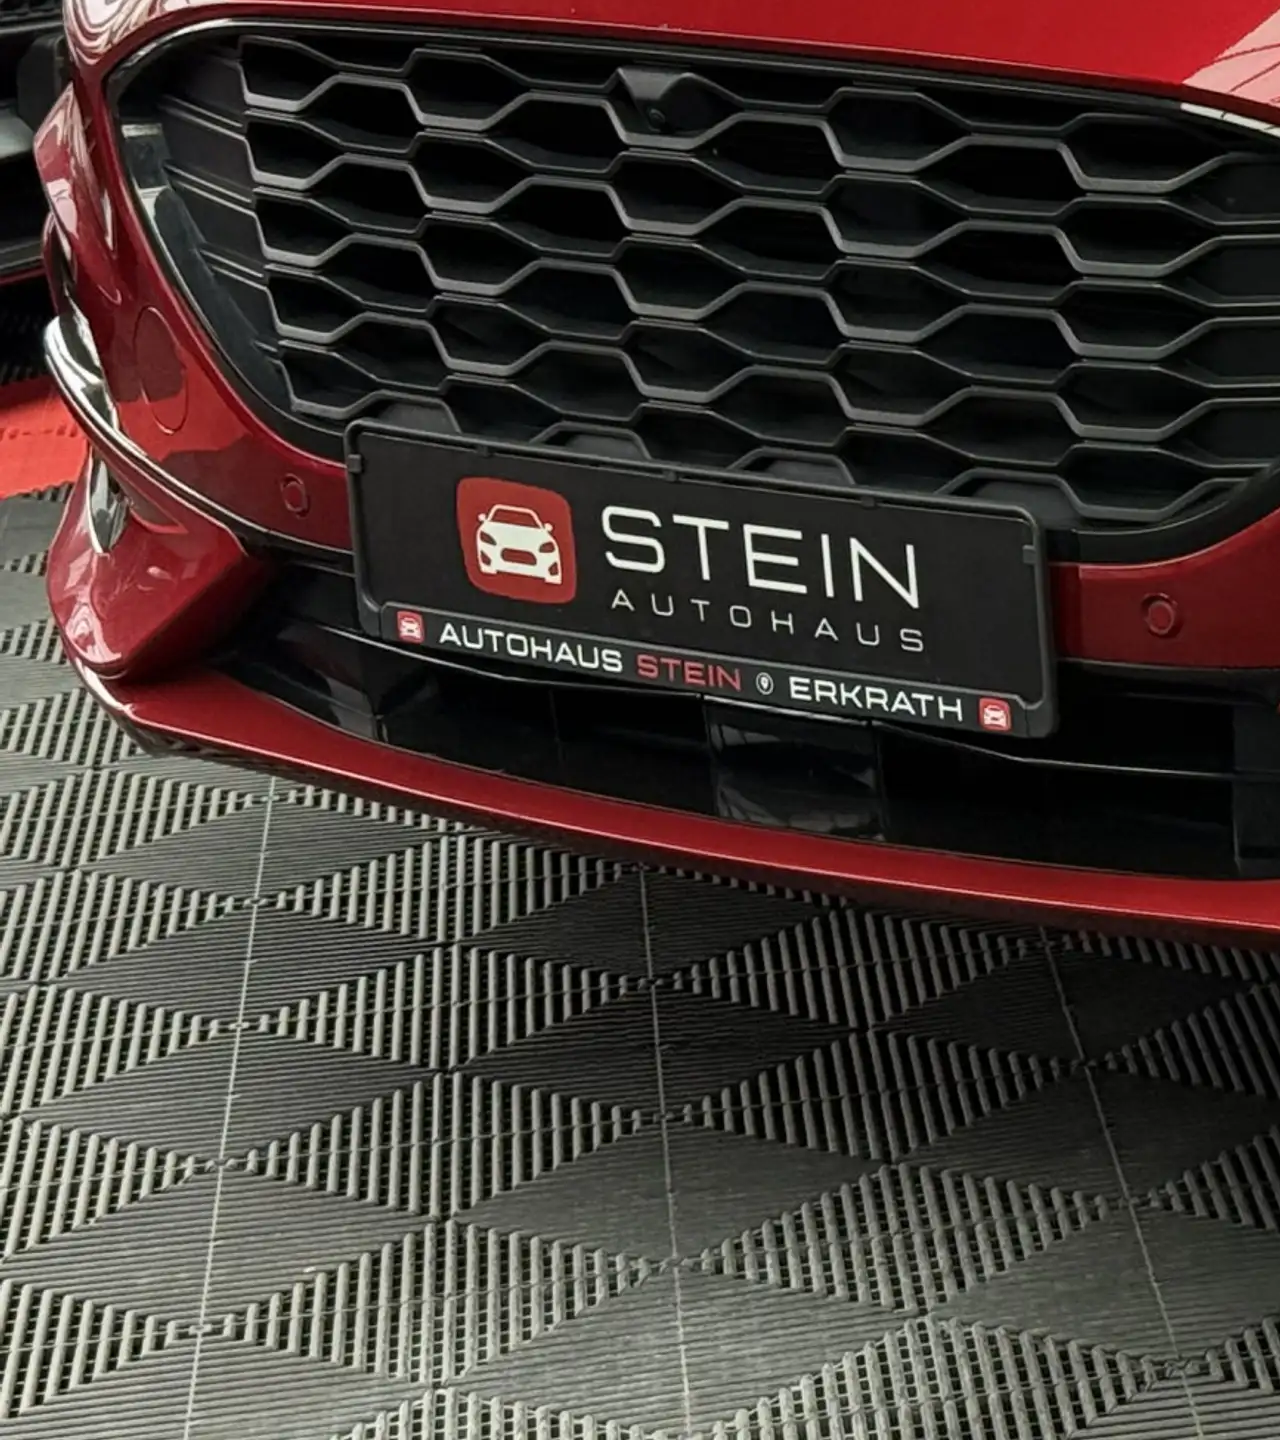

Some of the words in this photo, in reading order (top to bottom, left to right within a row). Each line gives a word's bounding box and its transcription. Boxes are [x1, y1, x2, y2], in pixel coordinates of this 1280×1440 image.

[602, 505, 920, 609] STEIN
[611, 589, 924, 652] AUTOHAUS
[439, 622, 623, 673] AUTOHAUS
[637, 654, 742, 691] STEIN
[789, 676, 963, 722] ERKRATH
